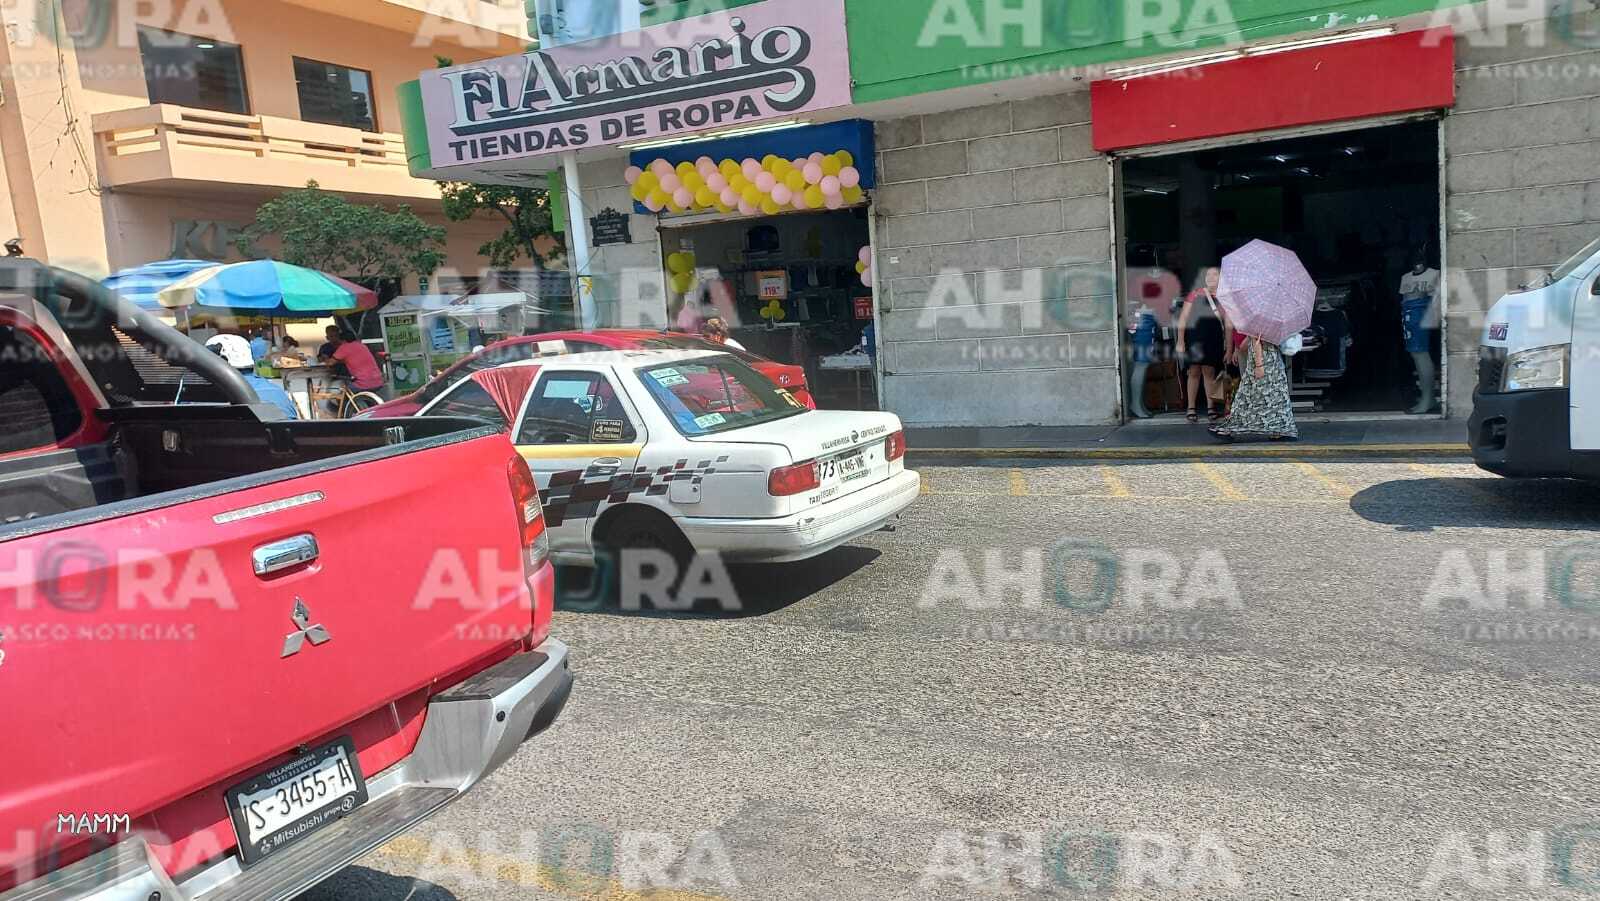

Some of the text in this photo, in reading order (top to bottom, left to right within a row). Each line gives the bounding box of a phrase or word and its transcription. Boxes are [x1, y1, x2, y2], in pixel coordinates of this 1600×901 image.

[448, 95, 761, 161] TIENDAS DE ROPA
[273, 813, 323, 847] Mitsubishi
